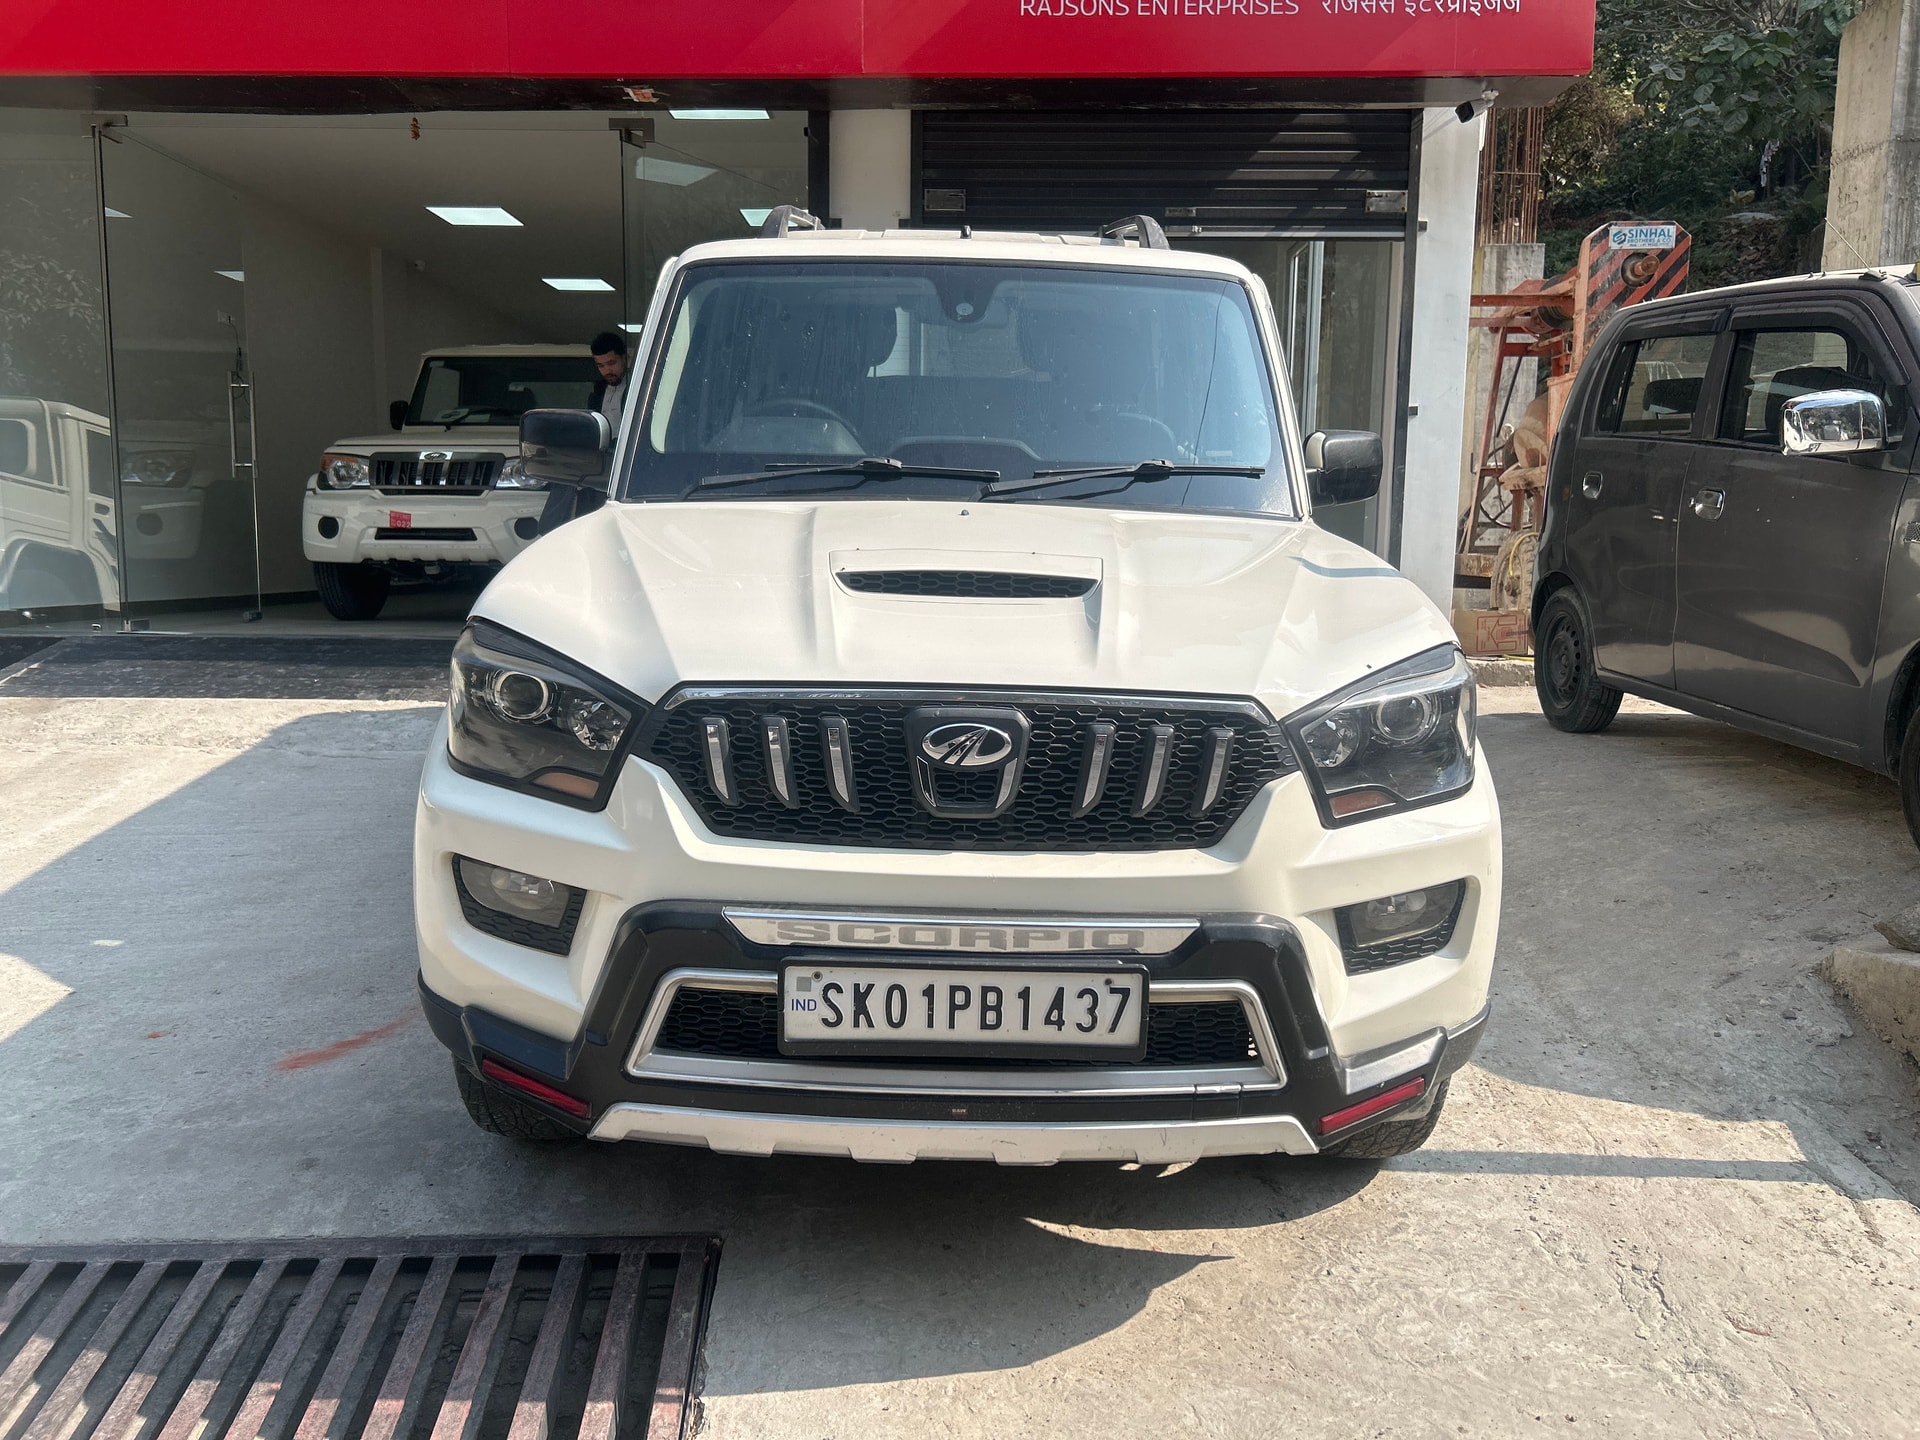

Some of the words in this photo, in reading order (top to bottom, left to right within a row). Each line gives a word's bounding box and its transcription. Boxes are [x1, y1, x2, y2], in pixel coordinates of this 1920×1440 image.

[1020, 0, 1130, 16] RAJSONS
[1136, 0, 1300, 16] ENTERPRISES
[1628, 228, 1672, 238] SINHAL
[777, 922, 1145, 950] SCORPIO
[791, 998, 817, 1012] IND
[821, 982, 1131, 1034] SK01PB1437
